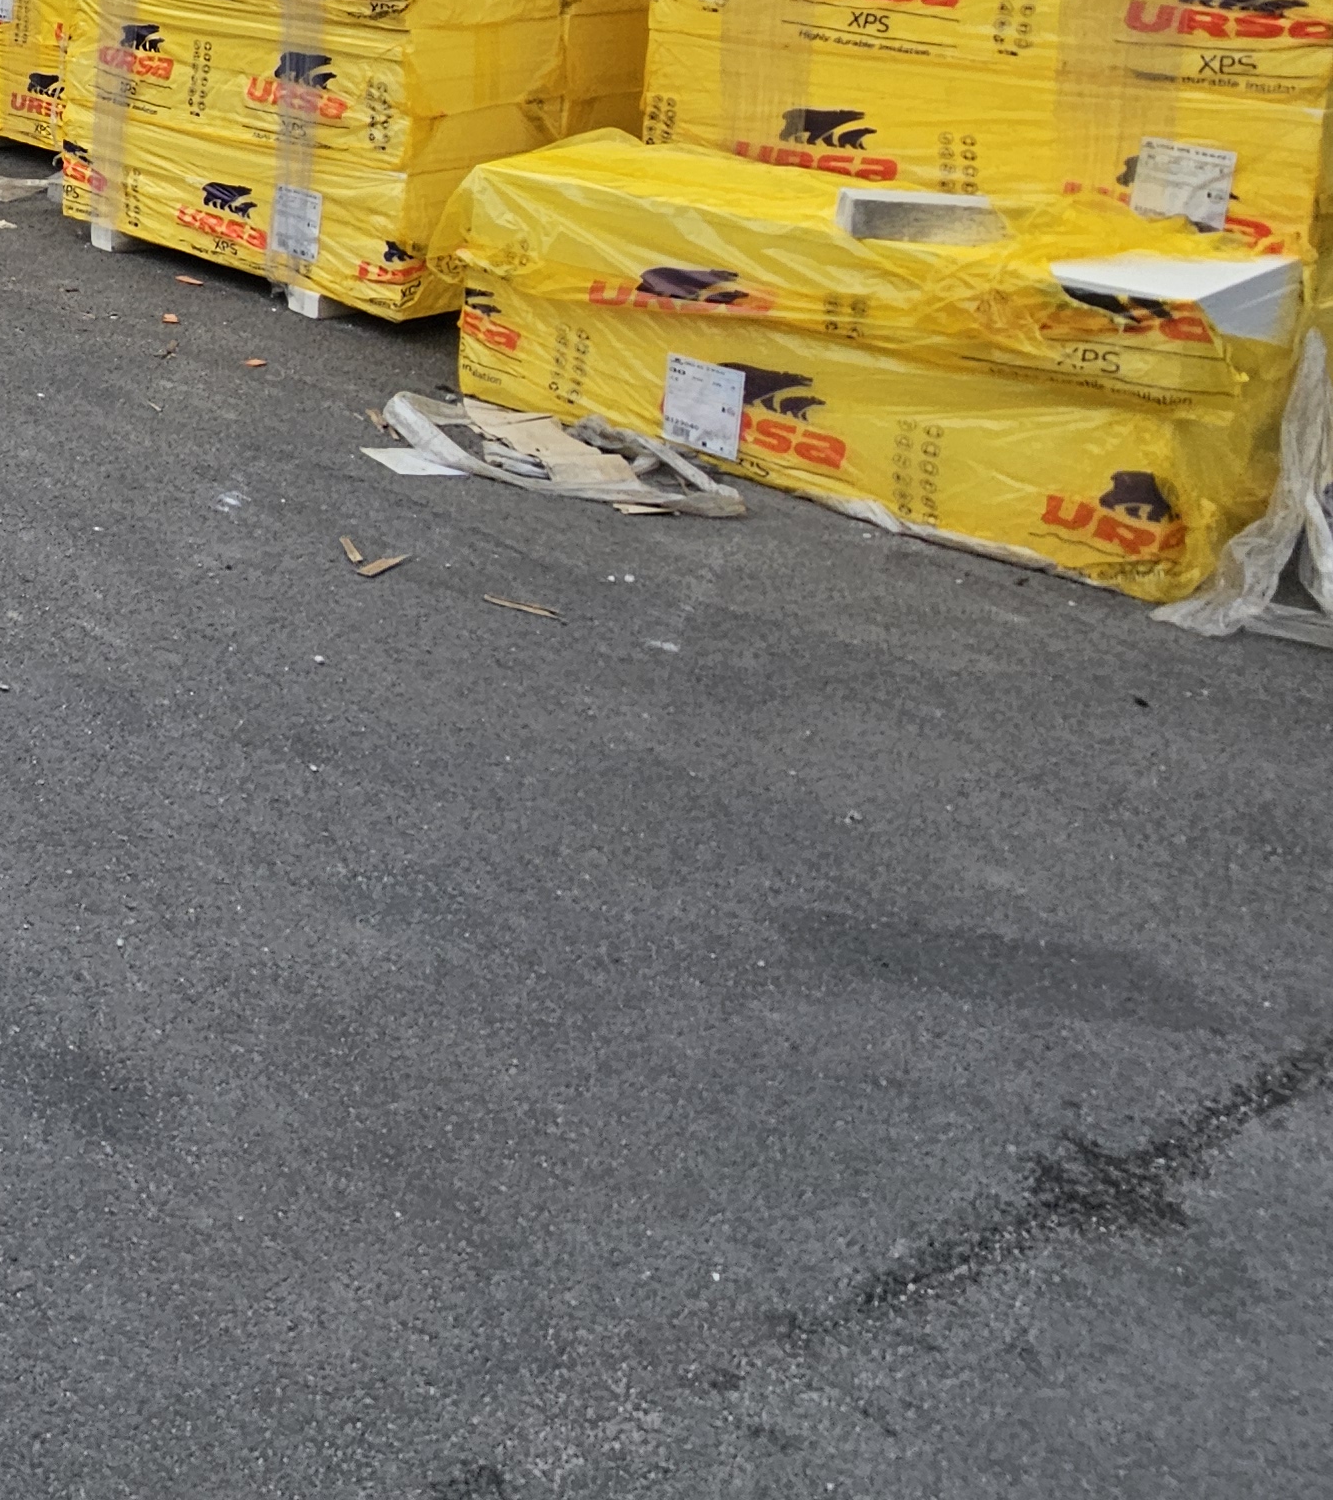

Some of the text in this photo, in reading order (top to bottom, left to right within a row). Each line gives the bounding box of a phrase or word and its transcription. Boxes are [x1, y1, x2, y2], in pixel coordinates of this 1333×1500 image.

[847, 11, 891, 34] XPS
[798, 28, 832, 45] Highly
[99, 45, 175, 81] URSA
[1196, 53, 1259, 76] XPS
[245, 75, 349, 121] URSA
[176, 202, 269, 250] URSA
[212, 236, 238, 256] XPS
